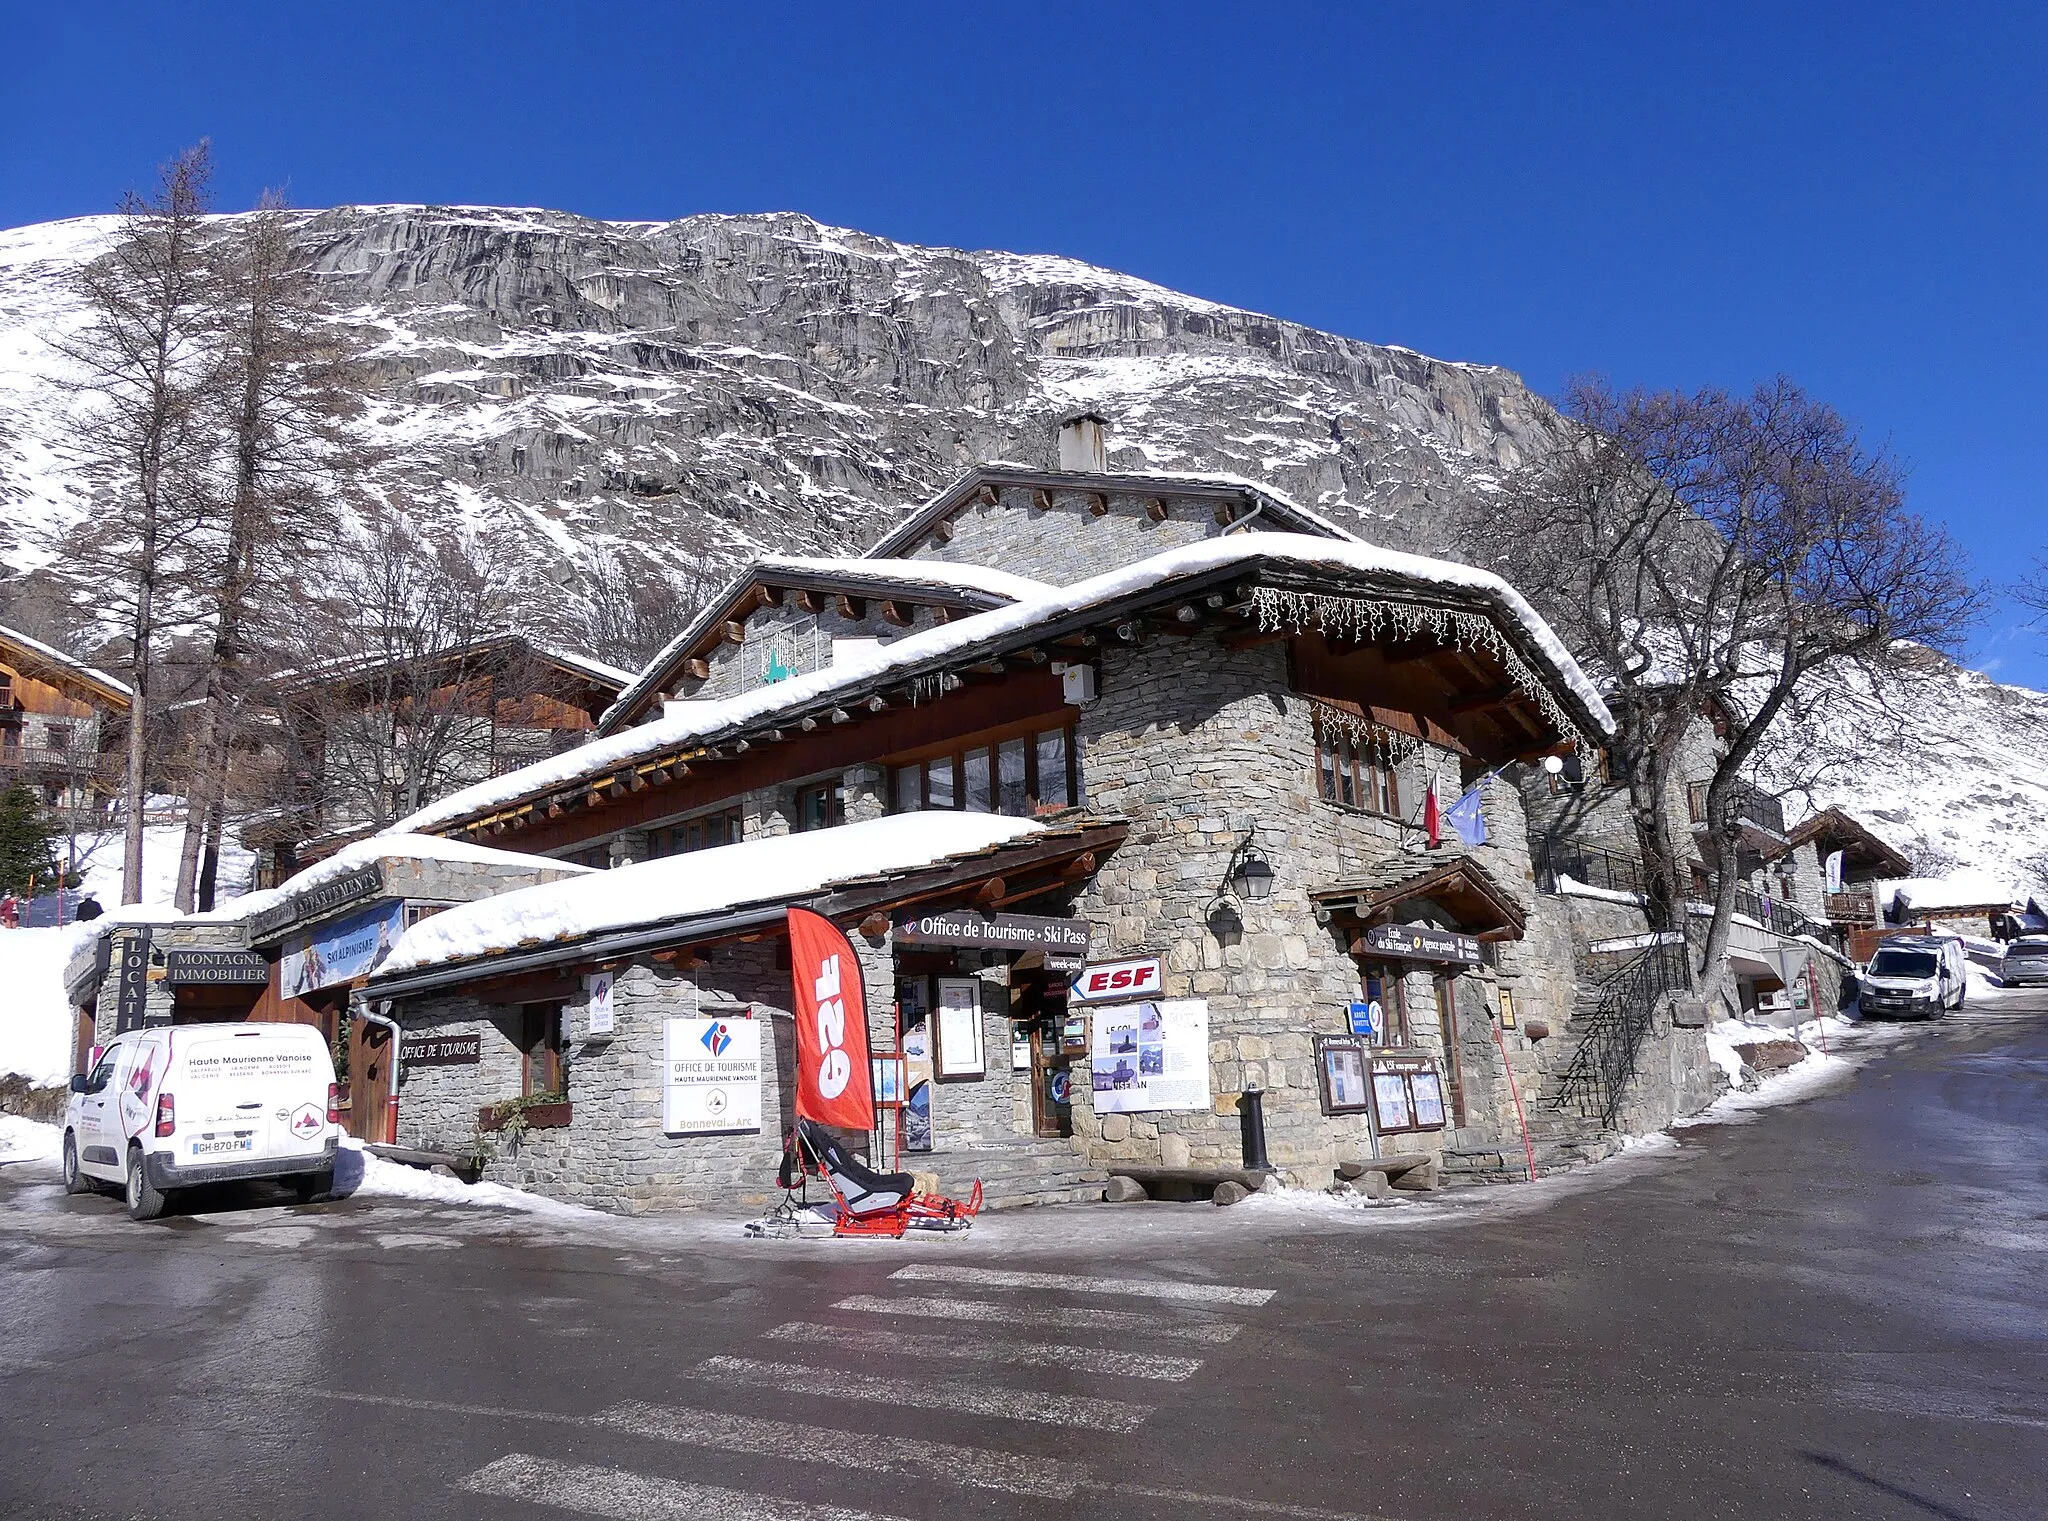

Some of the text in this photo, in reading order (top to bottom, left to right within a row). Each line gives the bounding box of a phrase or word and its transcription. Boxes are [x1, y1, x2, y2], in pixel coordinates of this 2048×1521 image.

[299, 870, 376, 913] APPARTEMENTS
[920, 917, 1086, 945] Office de Tourisme Ski Pass
[327, 938, 373, 964] SKI ALPINISME
[1422, 938, 1456, 953] Agence postale
[177, 953, 264, 966] MONTAGNE
[1050, 959, 1082, 970] week-end
[173, 969, 266, 981] IMMOBILIER
[1087, 966, 1155, 993] ESF
[401, 1041, 478, 1060] OFFICE DE TOURISME
[189, 1054, 312, 1066] Haute Maurienne Vanoise
[674, 1062, 757, 1073] OFFICE DE TOURISME
[696, 1075, 731, 1083] MAURIENNE
[680, 1117, 726, 1130] Bonneval
[736, 1117, 752, 1127] Arc
